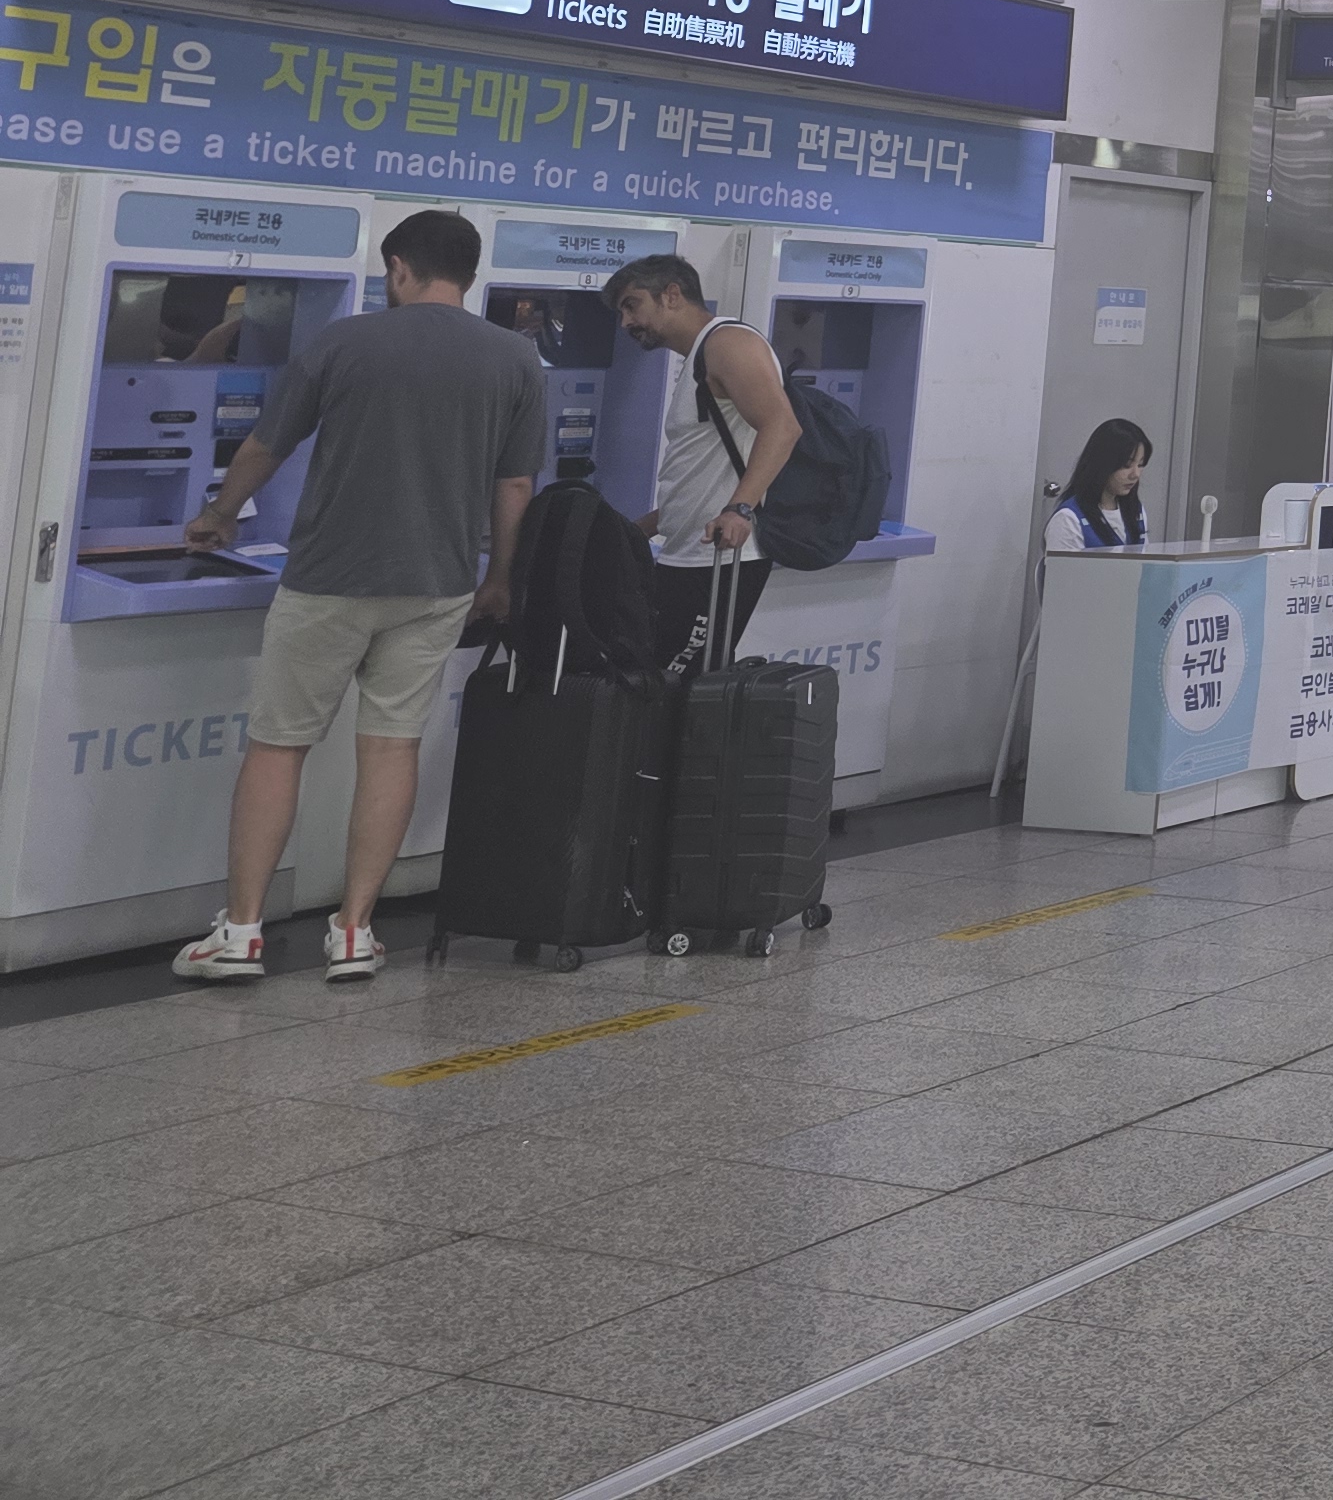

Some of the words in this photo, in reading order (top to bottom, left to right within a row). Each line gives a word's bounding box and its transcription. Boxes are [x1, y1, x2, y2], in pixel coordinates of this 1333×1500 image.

[643, 7, 746, 49] 自助售票机
[763, 28, 857, 68] 自動券売機
[0, 6, 217, 108] 구입은
[262, 41, 636, 151] 자동발매기가
[656, 104, 774, 158] 빠르고
[797, 122, 973, 190] 편리합니다.
[0, 111, 84, 147] ase
[107, 123, 182, 156] use
[203, 131, 225, 159] a
[247, 131, 357, 171] ticket
[375, 147, 518, 185] machine
[533, 158, 578, 190] for
[592, 170, 608, 192] a
[624, 170, 702, 200] quick
[714, 180, 840, 215] purchase.
[195, 207, 251, 227] 국내카드
[257, 212, 284, 231] 전용
[192, 230, 236, 243] Domestic
[236, 232, 259, 244] Card
[260, 234, 282, 248] Only
[558, 235, 601, 252] 국내카드
[605, 238, 626, 254] 전용
[235, 254, 244, 266] 7
[556, 254, 590, 265] Domestic
[590, 256, 607, 266] Card
[607, 258, 625, 269] Only
[827, 253, 863, 267] 국내카드
[866, 255, 883, 269] 전용
[584, 274, 592, 285] 8
[825, 269, 853, 279] Domestic
[853, 271, 868, 279] Card
[868, 272, 882, 282] Only
[847, 286, 854, 296] 9
[1289, 575, 1316, 589] 누구나
[1286, 595, 1322, 615] 코레일
[1186, 614, 1230, 647] 디지털
[1182, 647, 1226, 678] 누구나
[1183, 680, 1222, 712] 쉽게!
[67, 712, 250, 775] TICKET
